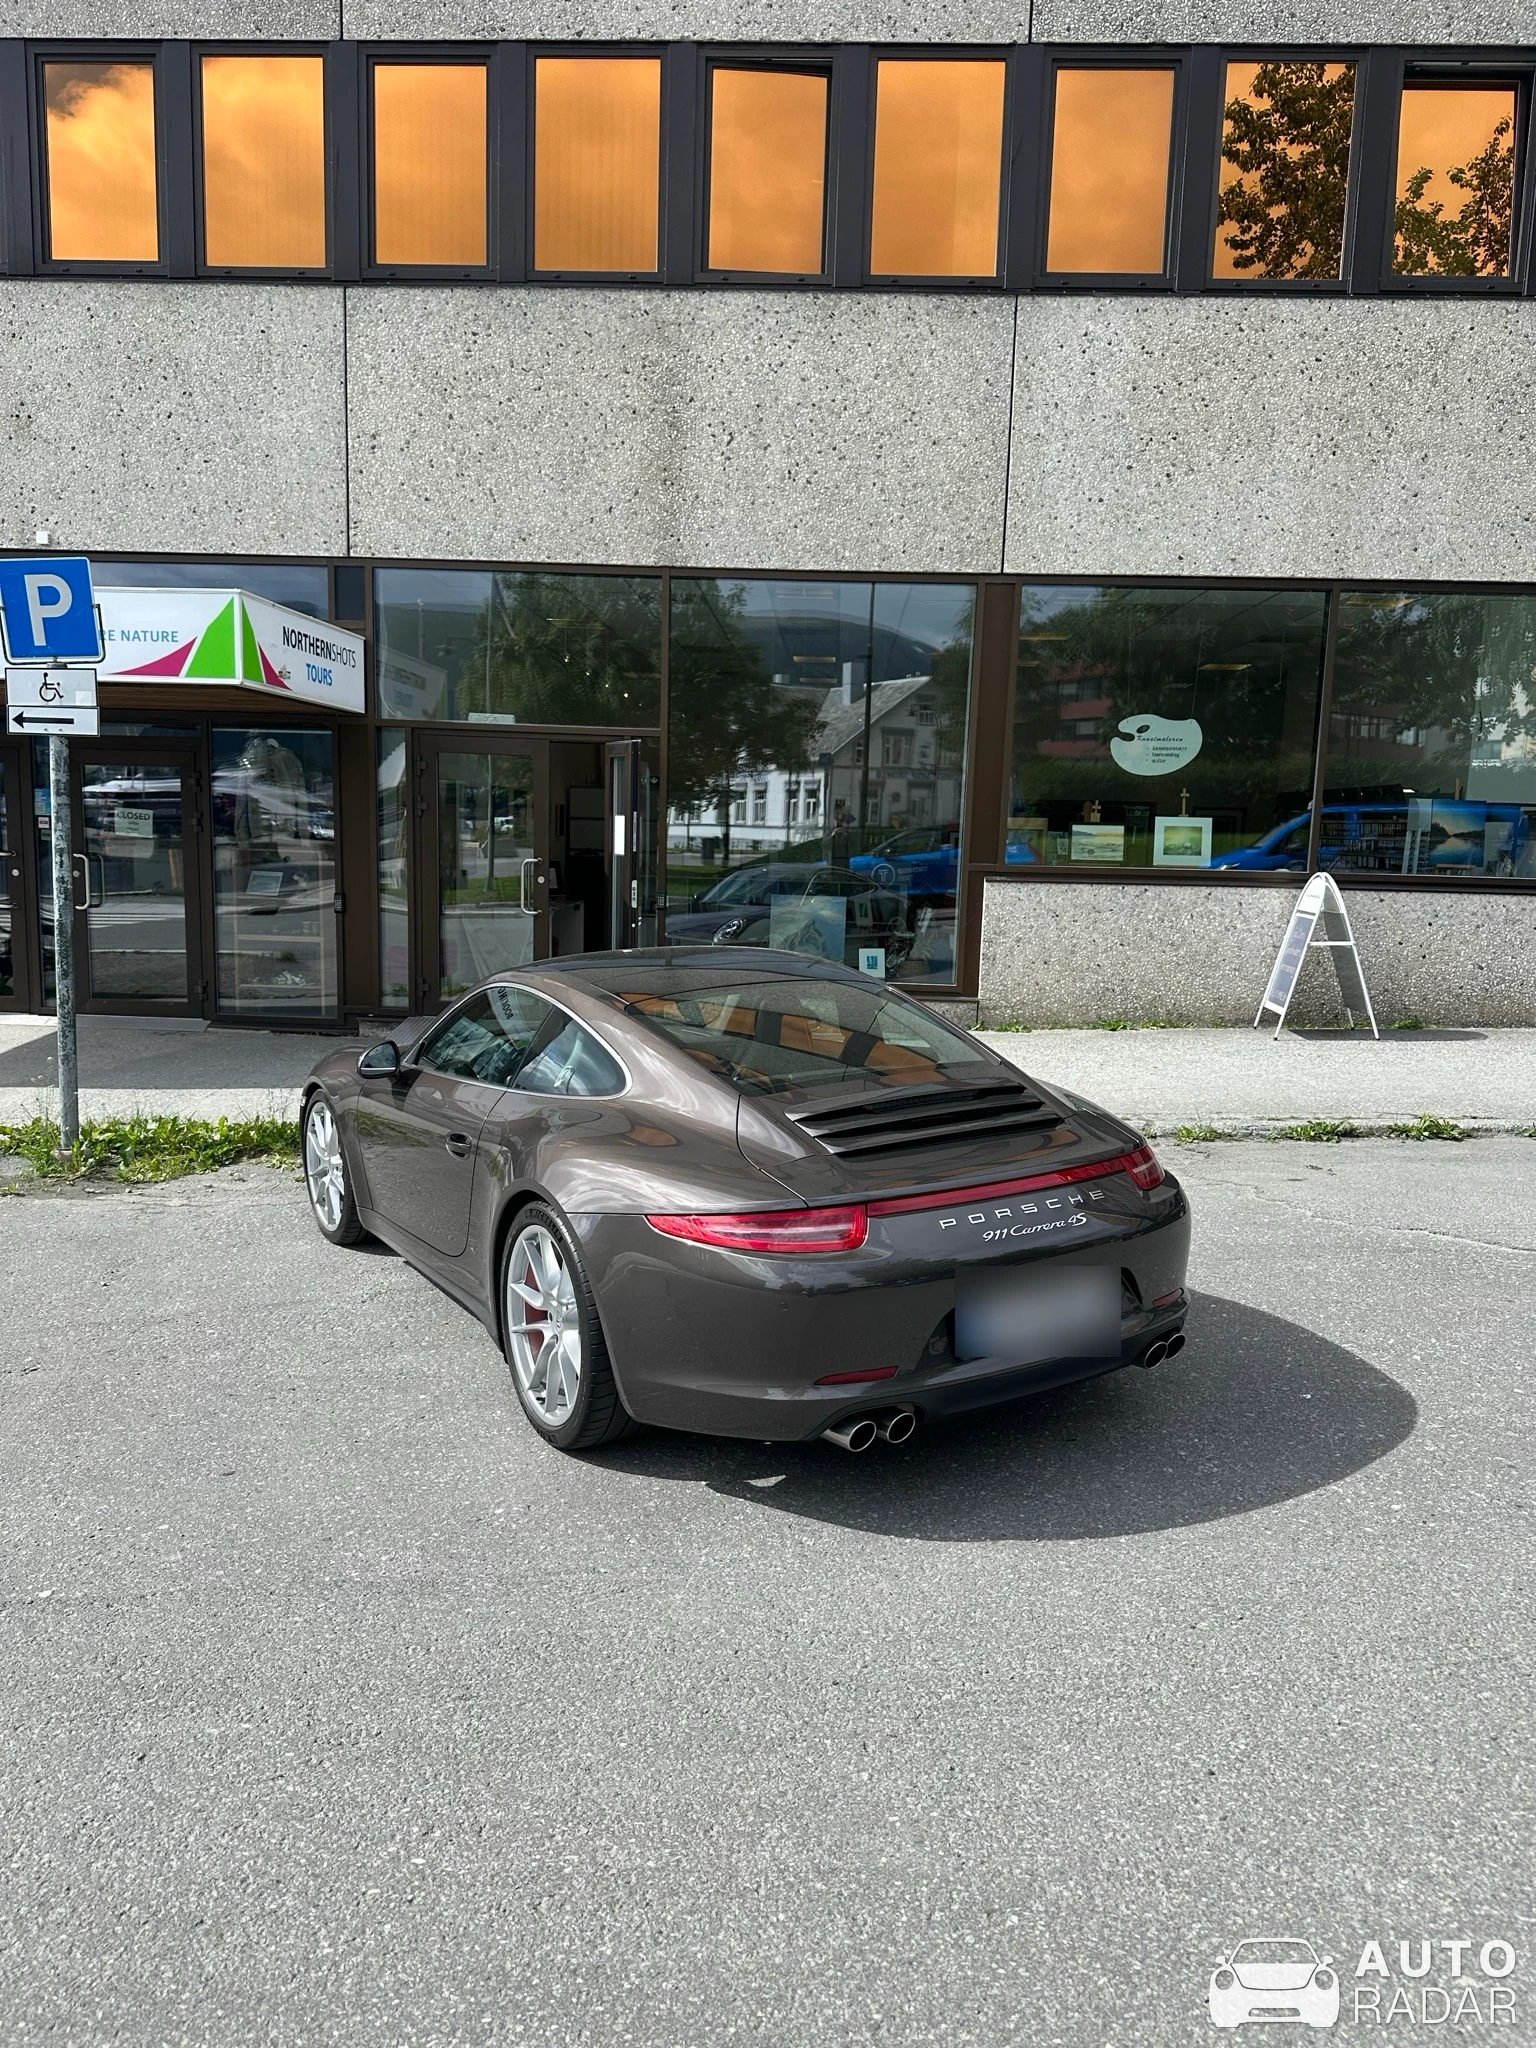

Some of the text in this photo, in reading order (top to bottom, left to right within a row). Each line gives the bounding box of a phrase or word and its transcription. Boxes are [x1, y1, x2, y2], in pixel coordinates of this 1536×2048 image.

[24, 573, 73, 647] P
[120, 629, 179, 643] NATURE
[282, 625, 357, 668] NORTHERNSHOTS
[305, 662, 333, 687] TOURS
[116, 811, 151, 821] CLOSED
[938, 1189, 1106, 1230] PORSCHE
[982, 1212, 1088, 1242] 911 Carrera 4S
